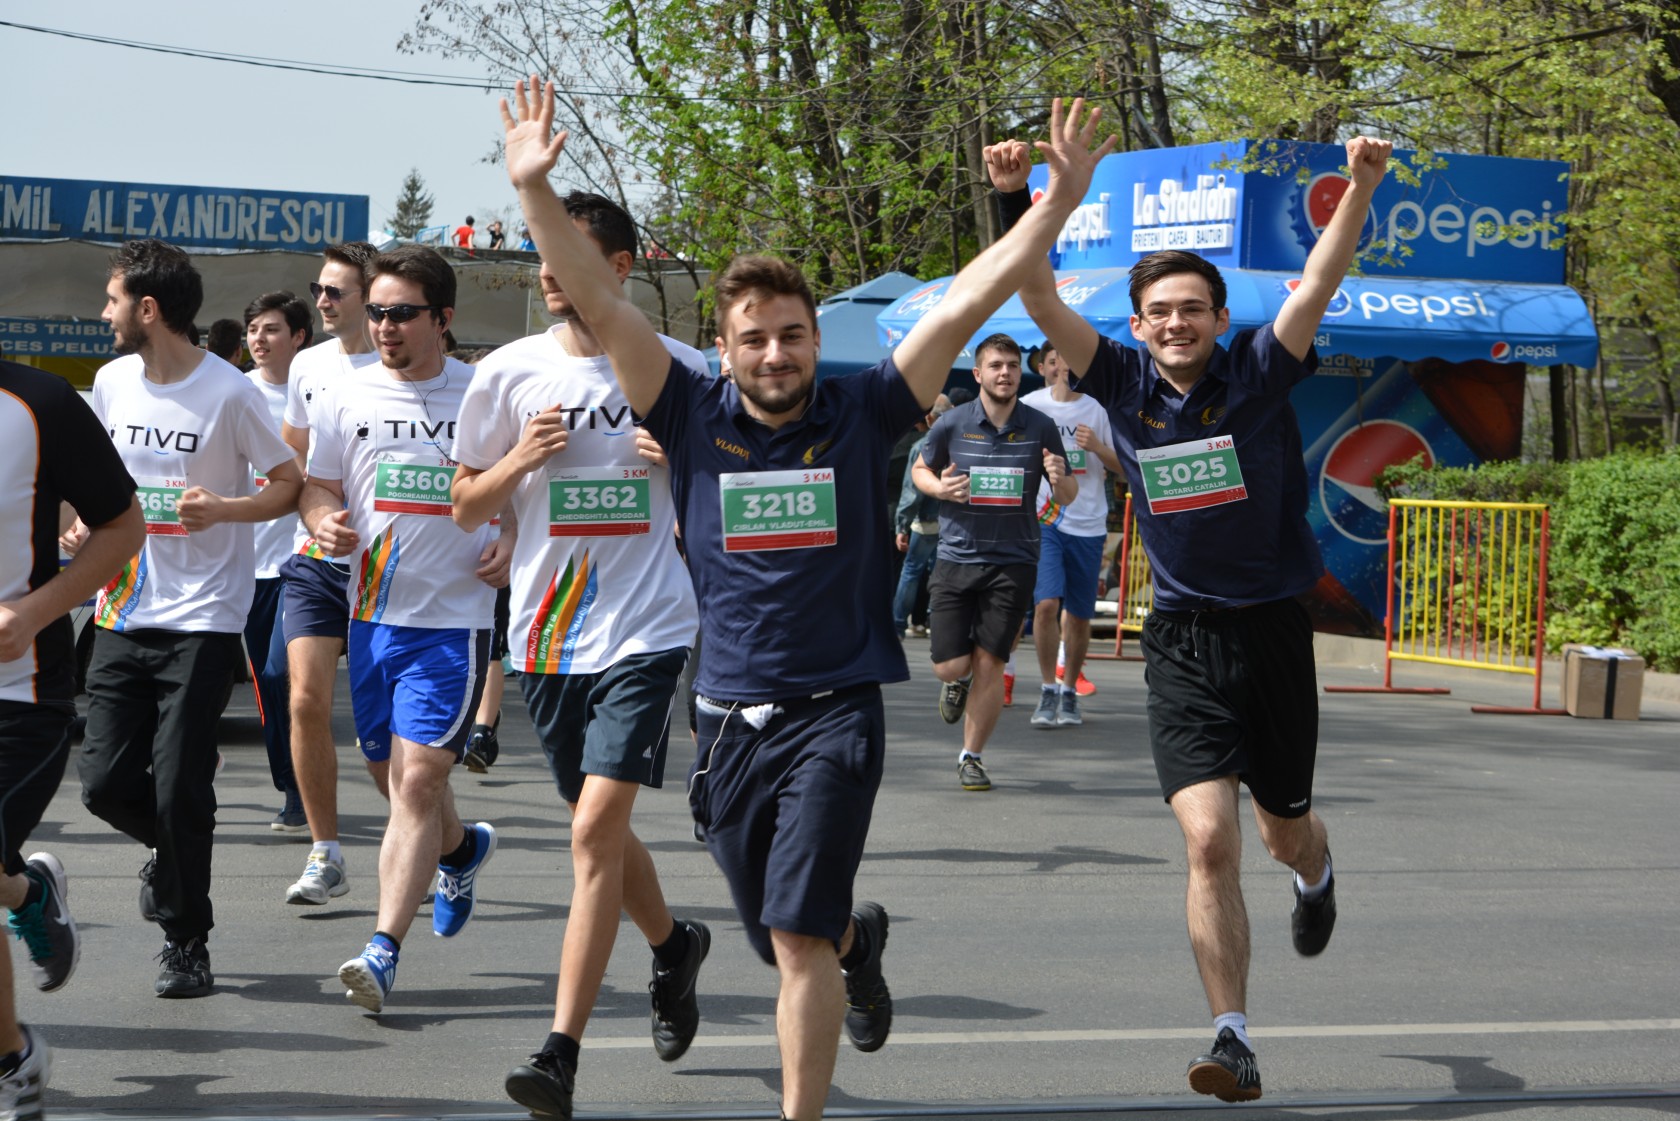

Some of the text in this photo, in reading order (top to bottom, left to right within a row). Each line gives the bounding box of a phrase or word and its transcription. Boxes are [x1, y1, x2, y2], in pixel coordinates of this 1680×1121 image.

[1133, 174, 1237, 226] La Stadion
[0, 184, 346, 245] MiL ALEXANDRESCU
[1386, 200, 1554, 258] pepsi
[1168, 231, 1189, 246] CAFEA
[1196, 229, 1224, 245] BAUTURI
[1359, 291, 1489, 323] pepsi
[1514, 344, 1558, 360] pepsi
[1206, 439, 1233, 451] 3 KM
[439, 458, 444, 467] 3
[623, 469, 648, 479] 3 KM
[803, 472, 832, 483] 3 KM
[1154, 456, 1228, 487] 3025
[165, 479, 186, 488] 3 KM
[385, 468, 451, 492] 3360
[979, 476, 1015, 491] 3221
[1162, 480, 1228, 496] ROTARU CATALIN
[387, 491, 431, 500] POGOREANU
[563, 485, 638, 510] 3362
[741, 490, 817, 519] 3218
[556, 512, 645, 521] GHEORGHITA BOGDAN
[732, 518, 829, 532] CIRLAN VLADUT-EMIL
[563, 588, 595, 661] COMMUNITY
[528, 620, 541, 660] ENJOY
